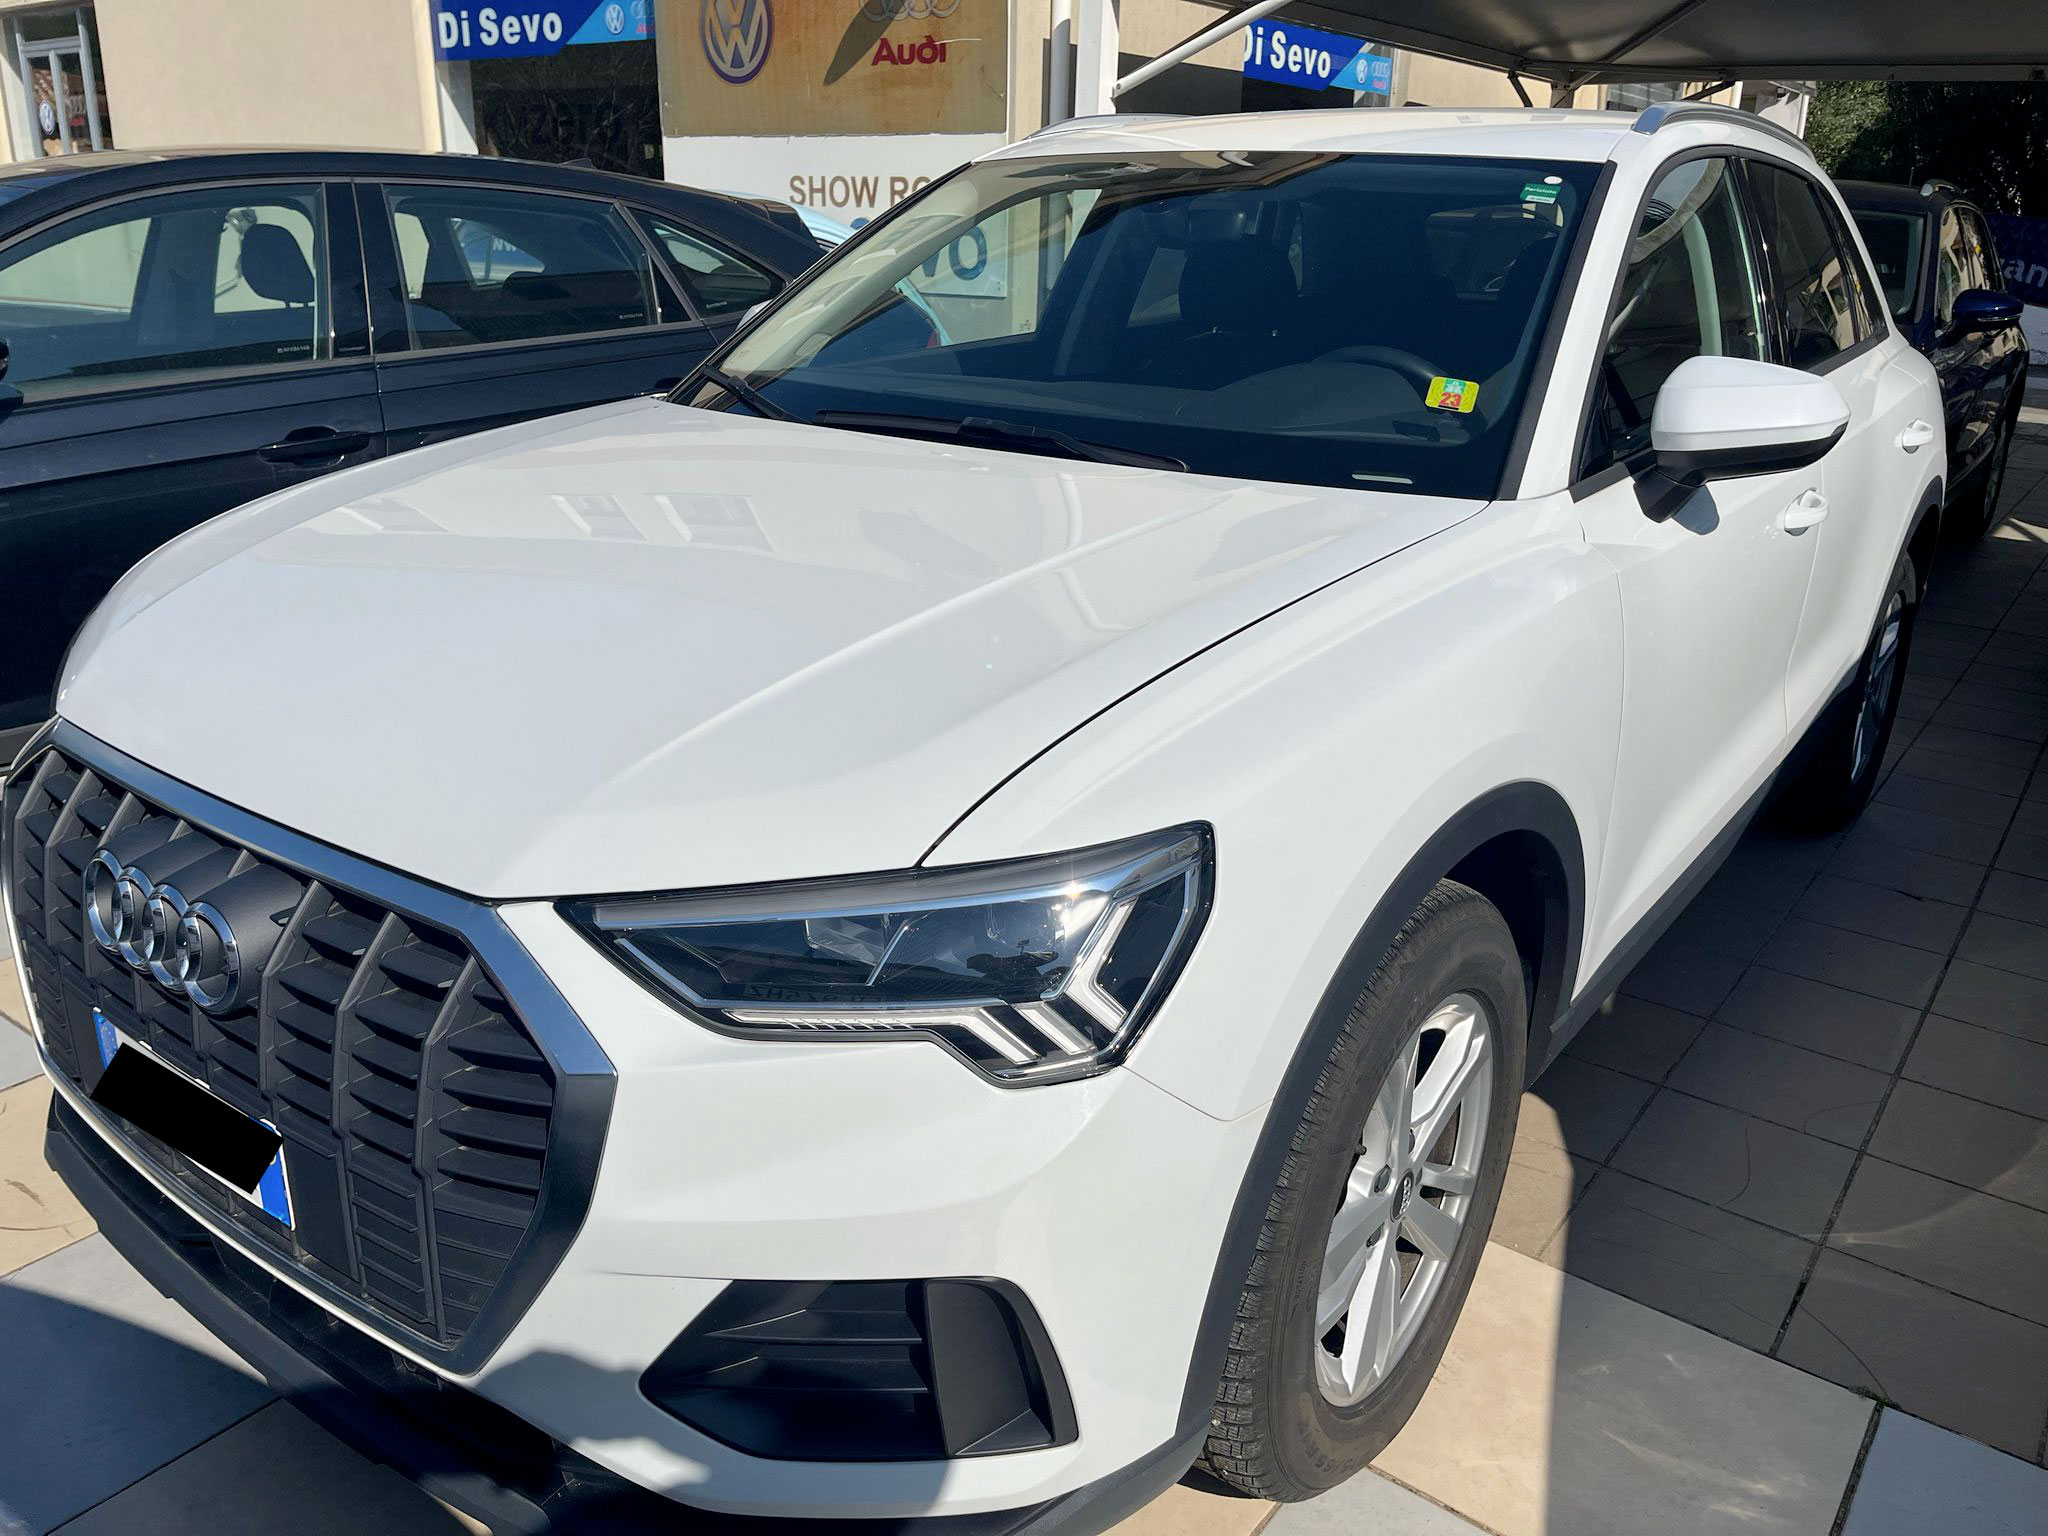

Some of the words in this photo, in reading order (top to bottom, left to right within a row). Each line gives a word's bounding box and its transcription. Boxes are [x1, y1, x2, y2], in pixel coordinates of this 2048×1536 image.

[437, 10, 471, 49] Di
[479, 7, 563, 46] Sevo
[1270, 30, 1331, 78] Sevo
[789, 175, 879, 208] SHOW
[2000, 258, 2048, 288] an
[1440, 391, 1462, 408] 23
